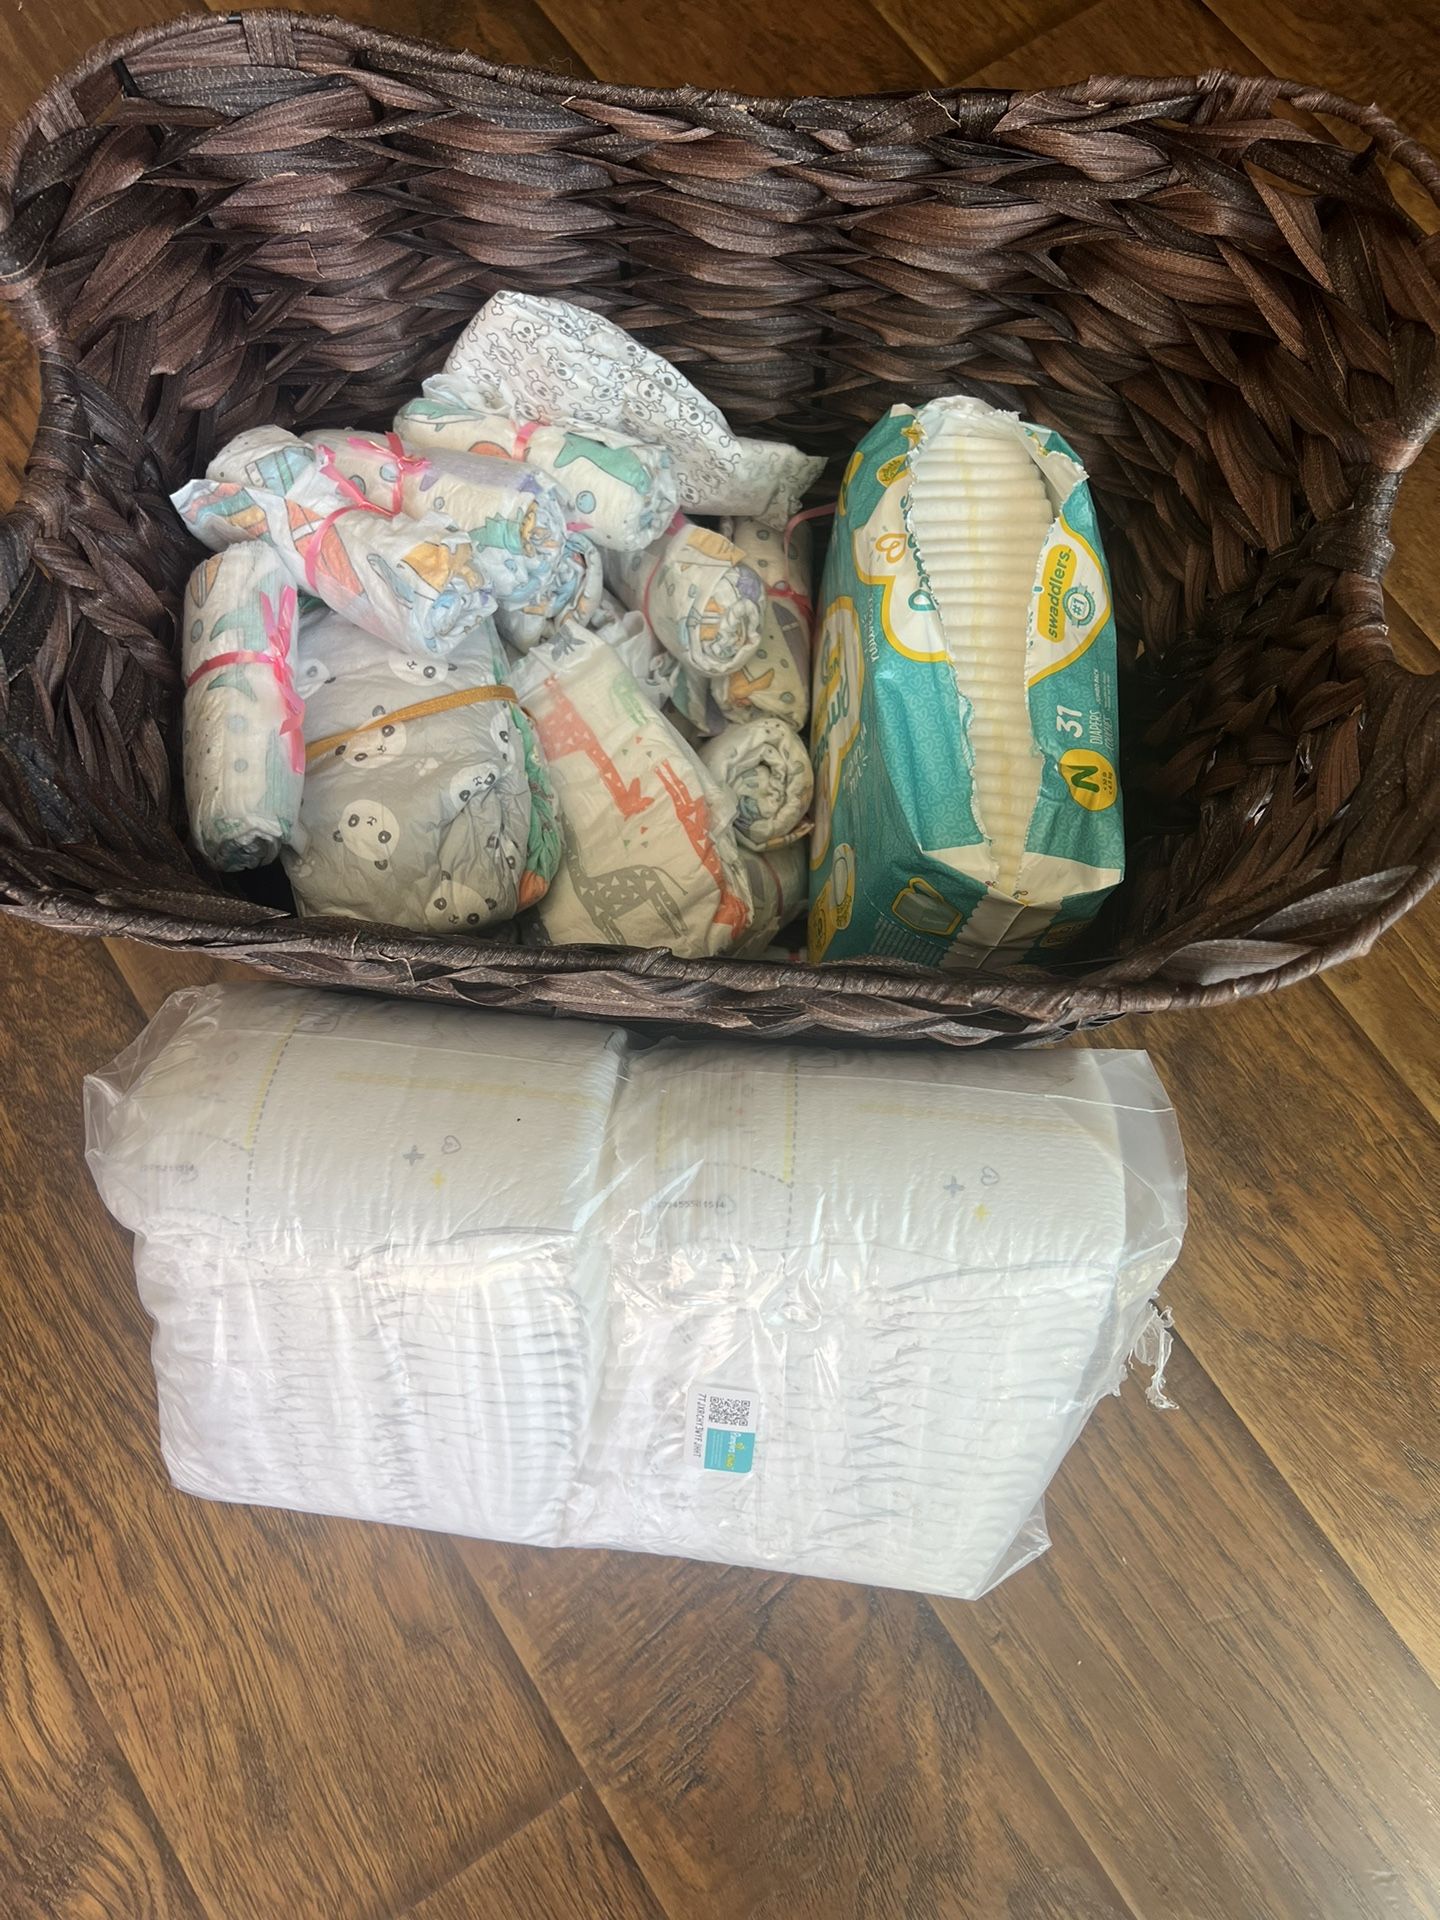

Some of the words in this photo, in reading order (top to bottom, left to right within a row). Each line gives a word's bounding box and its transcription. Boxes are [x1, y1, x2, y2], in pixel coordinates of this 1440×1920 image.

[1046, 551, 1071, 639] swaddlers
[1071, 597, 1085, 616] #1
[1056, 704, 1083, 738] 31
[1088, 710, 1103, 745] DIAPERS
[1066, 765, 1100, 793] N
